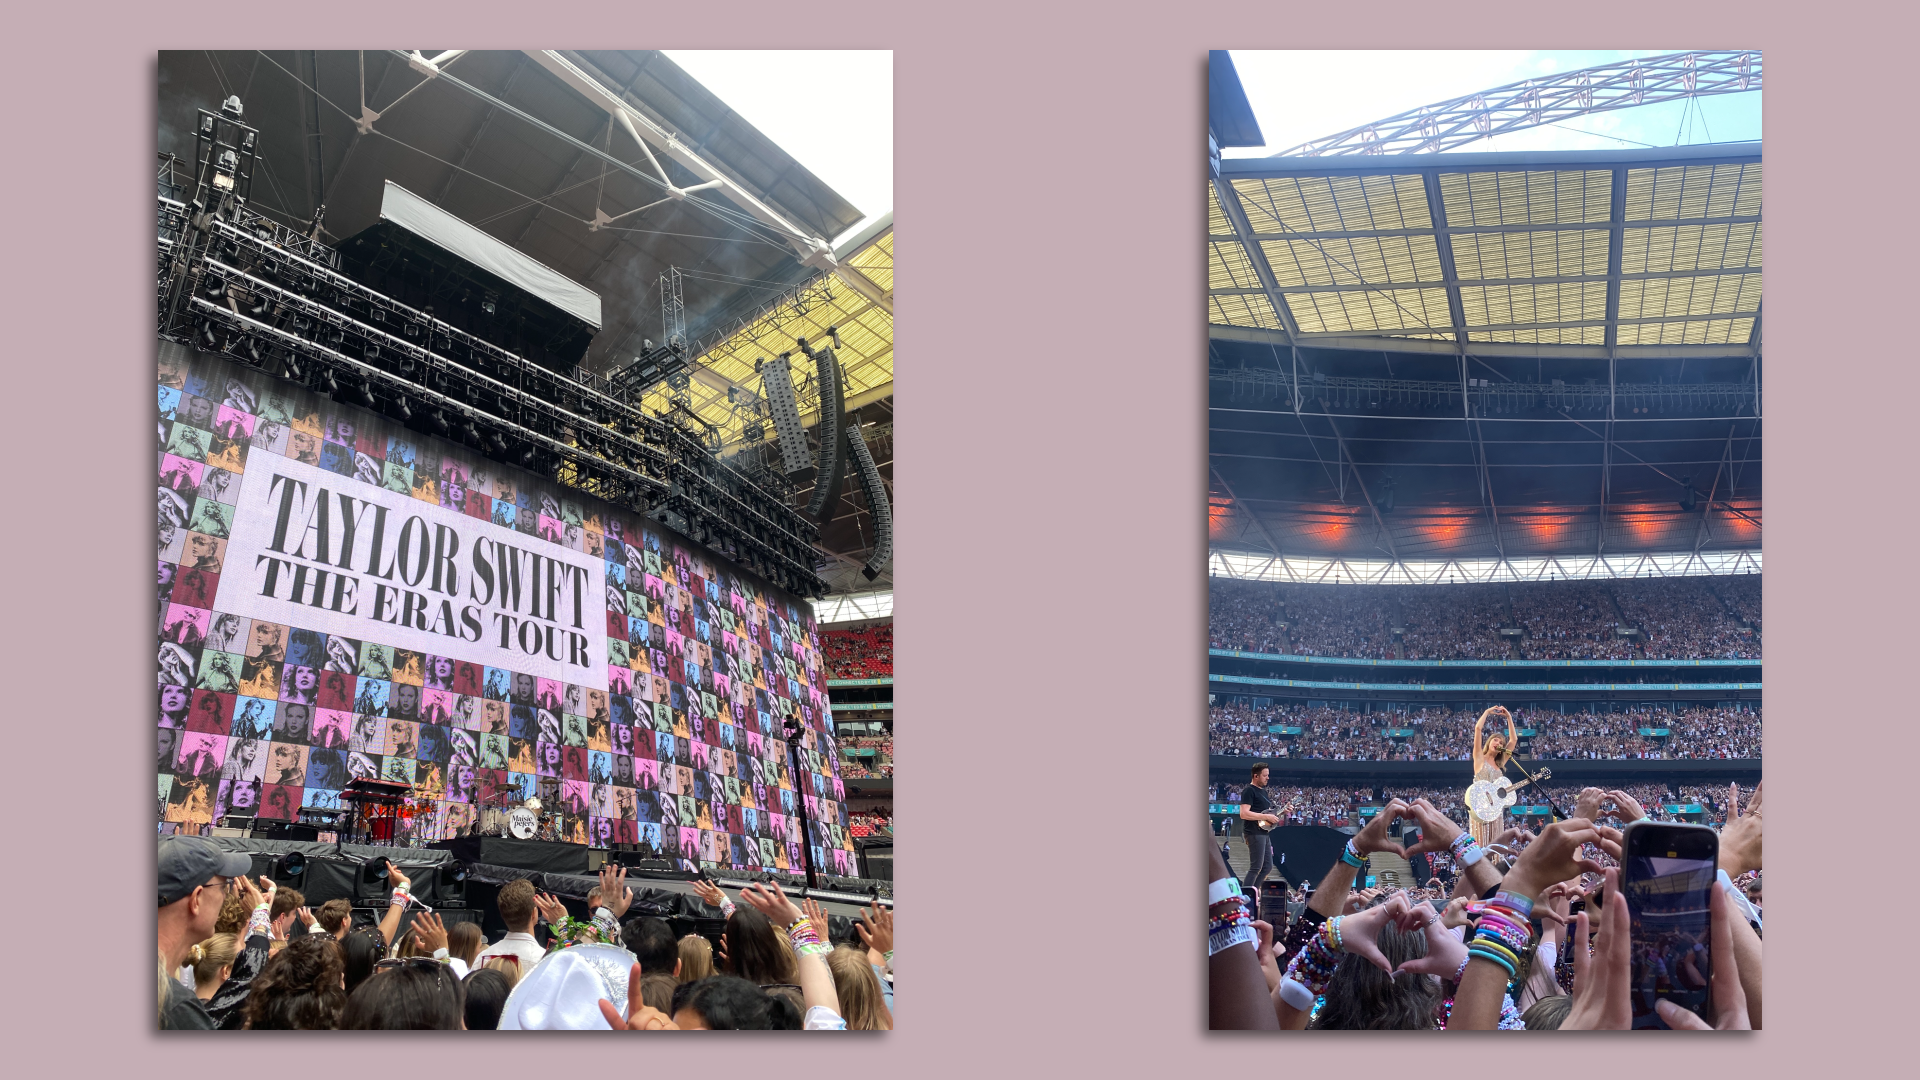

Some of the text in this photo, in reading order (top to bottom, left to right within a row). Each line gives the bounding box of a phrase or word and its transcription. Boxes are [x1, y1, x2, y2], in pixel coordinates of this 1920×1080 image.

[255, 554, 592, 669] THE ERAS TOUR
[265, 474, 589, 630] TAYLOR SWIFT
